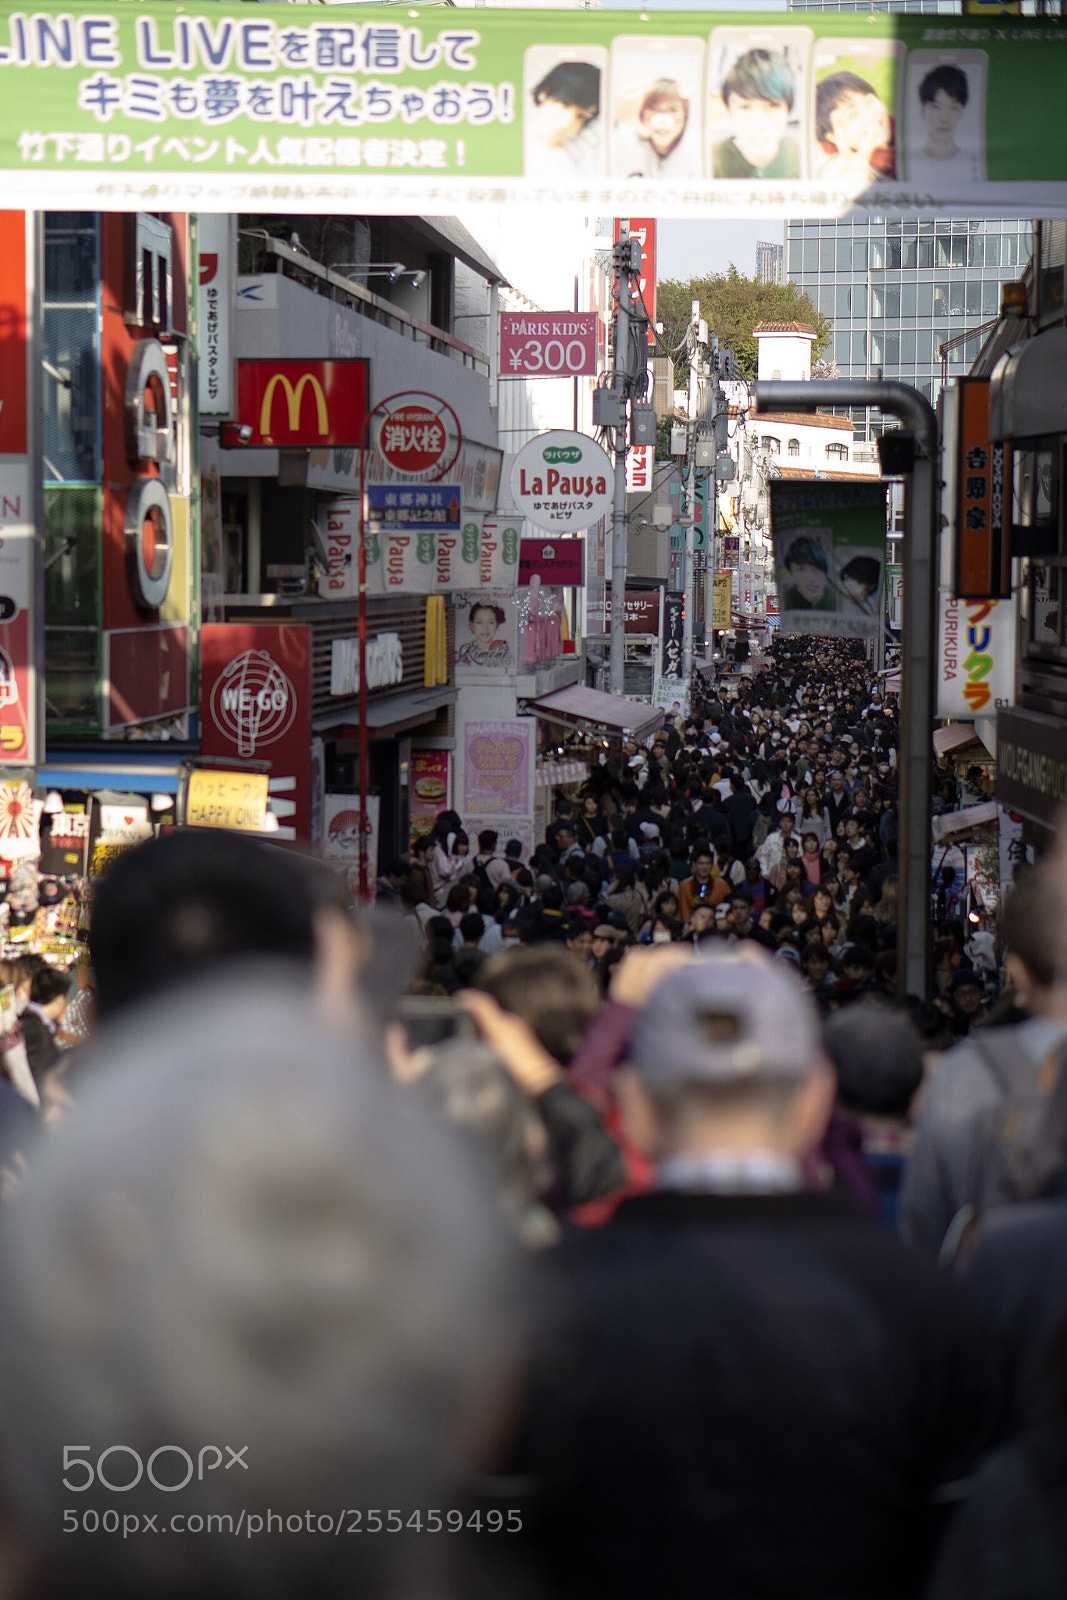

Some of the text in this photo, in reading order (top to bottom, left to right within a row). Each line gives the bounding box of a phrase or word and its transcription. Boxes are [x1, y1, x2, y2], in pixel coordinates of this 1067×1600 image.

[85, 77, 512, 121] キミも夢を叶えちゃおう!
[510, 318, 588, 336] PARIS KID'S
[509, 340, 587, 371] ¥300
[384, 425, 443, 452] 消火栓
[544, 450, 581, 459] ラパウザ
[546, 468, 607, 498] Pausa
[384, 490, 444, 506] 東郷神社
[533, 501, 594, 511] ゆであげパスタ
[387, 536, 411, 585] Pausa
[437, 538, 457, 583] Pausa
[712, 579, 728, 588] AFE
[943, 598, 958, 682] PURIKURA
[963, 599, 999, 713] プリクラ
[190, 805, 262, 825] HAPPY ONE
